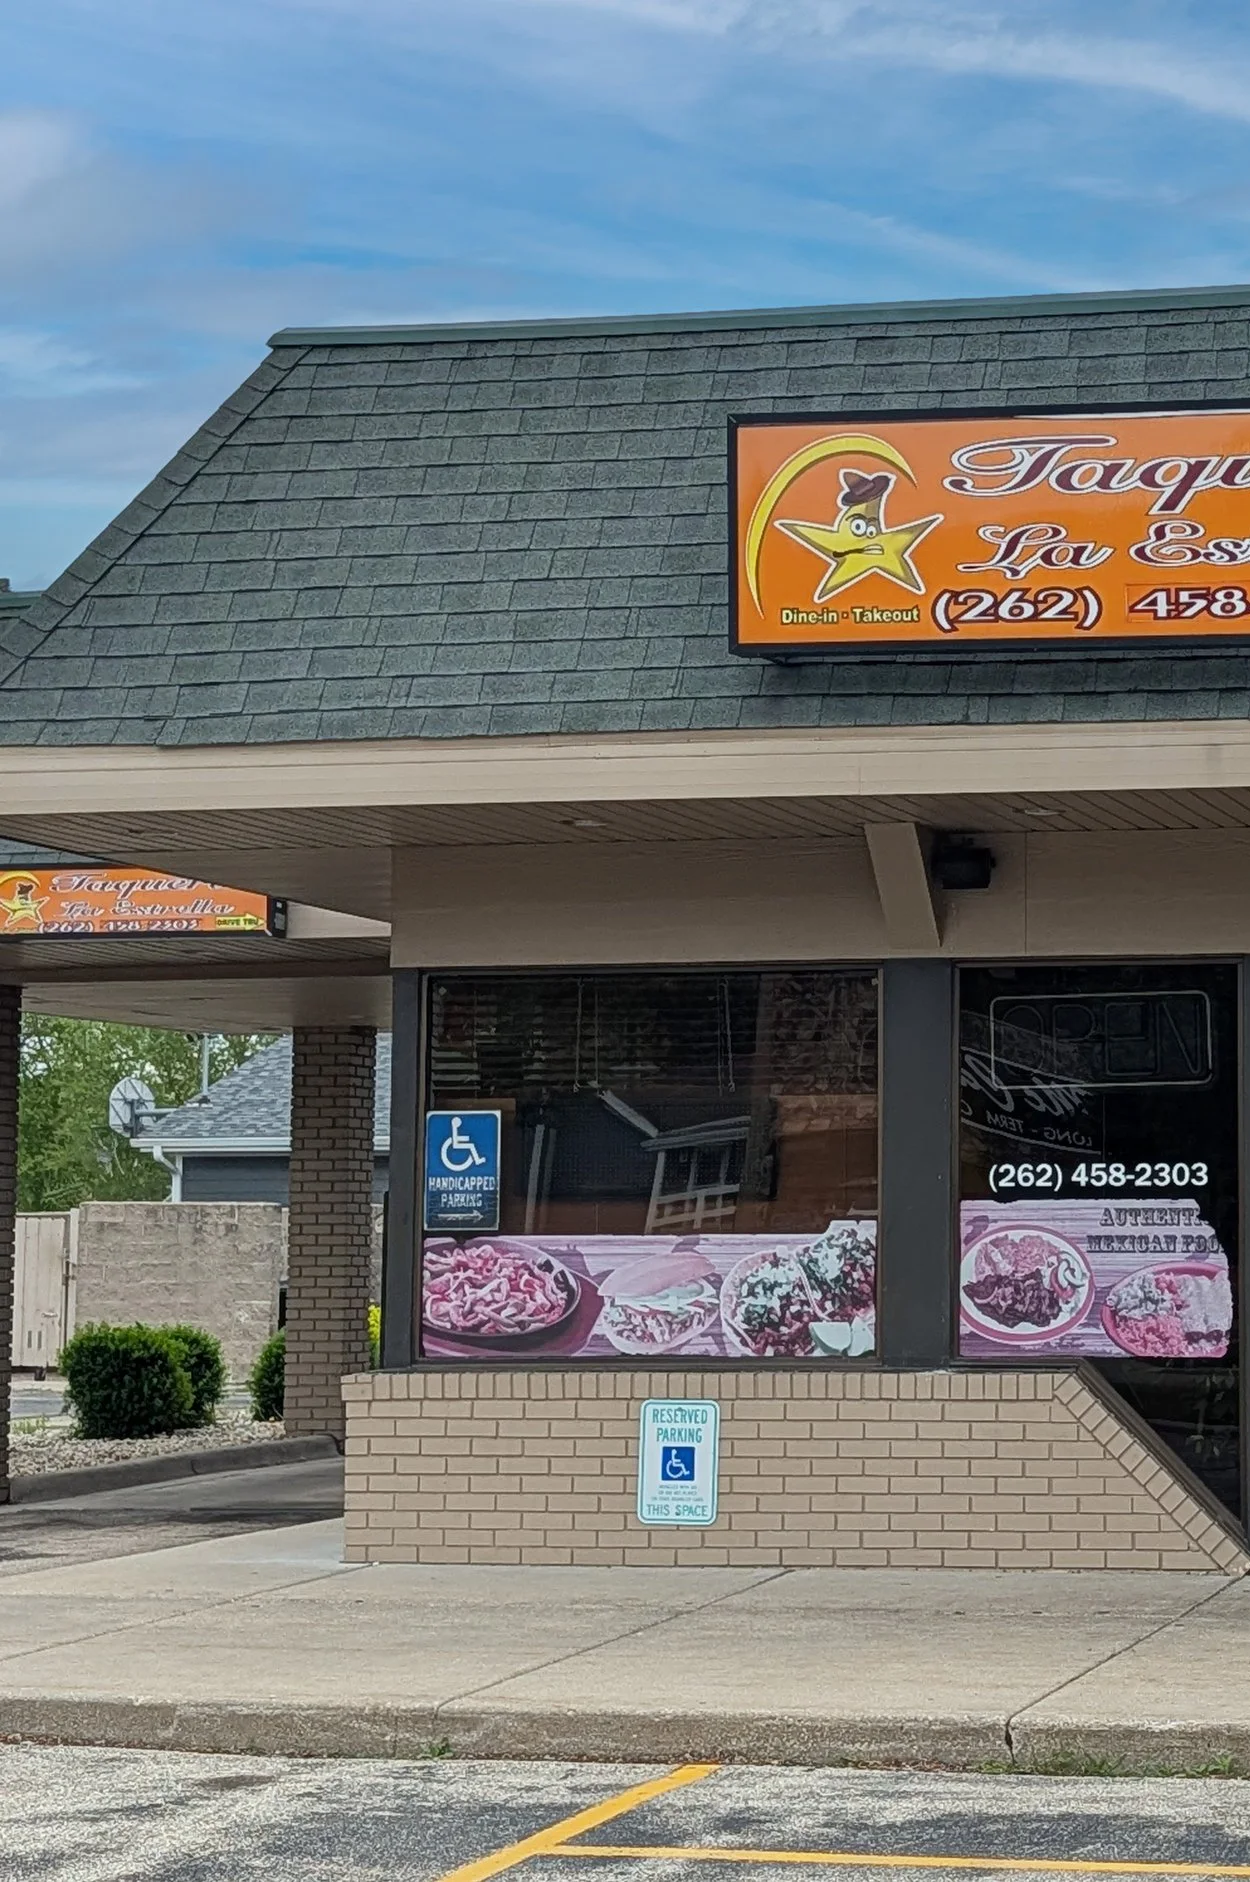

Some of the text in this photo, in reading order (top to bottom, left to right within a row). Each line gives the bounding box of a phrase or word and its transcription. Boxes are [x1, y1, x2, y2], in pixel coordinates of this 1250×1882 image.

[957, 523, 1114, 579] La
[781, 605, 920, 625] Dine-in Takeout
[931, 585, 1102, 633] (262)
[1000, 1002, 1202, 1076] OPEN
[428, 1176, 496, 1191] HANDICAPPED
[989, 1162, 1208, 1193] (262) 458-2303
[441, 1194, 482, 1208] PARKING
[1086, 1234, 1178, 1253] MEXICAN
[652, 1408, 708, 1424] RESERVED
[656, 1428, 702, 1443] PARKING
[646, 1504, 709, 1517] THIS SPACE
